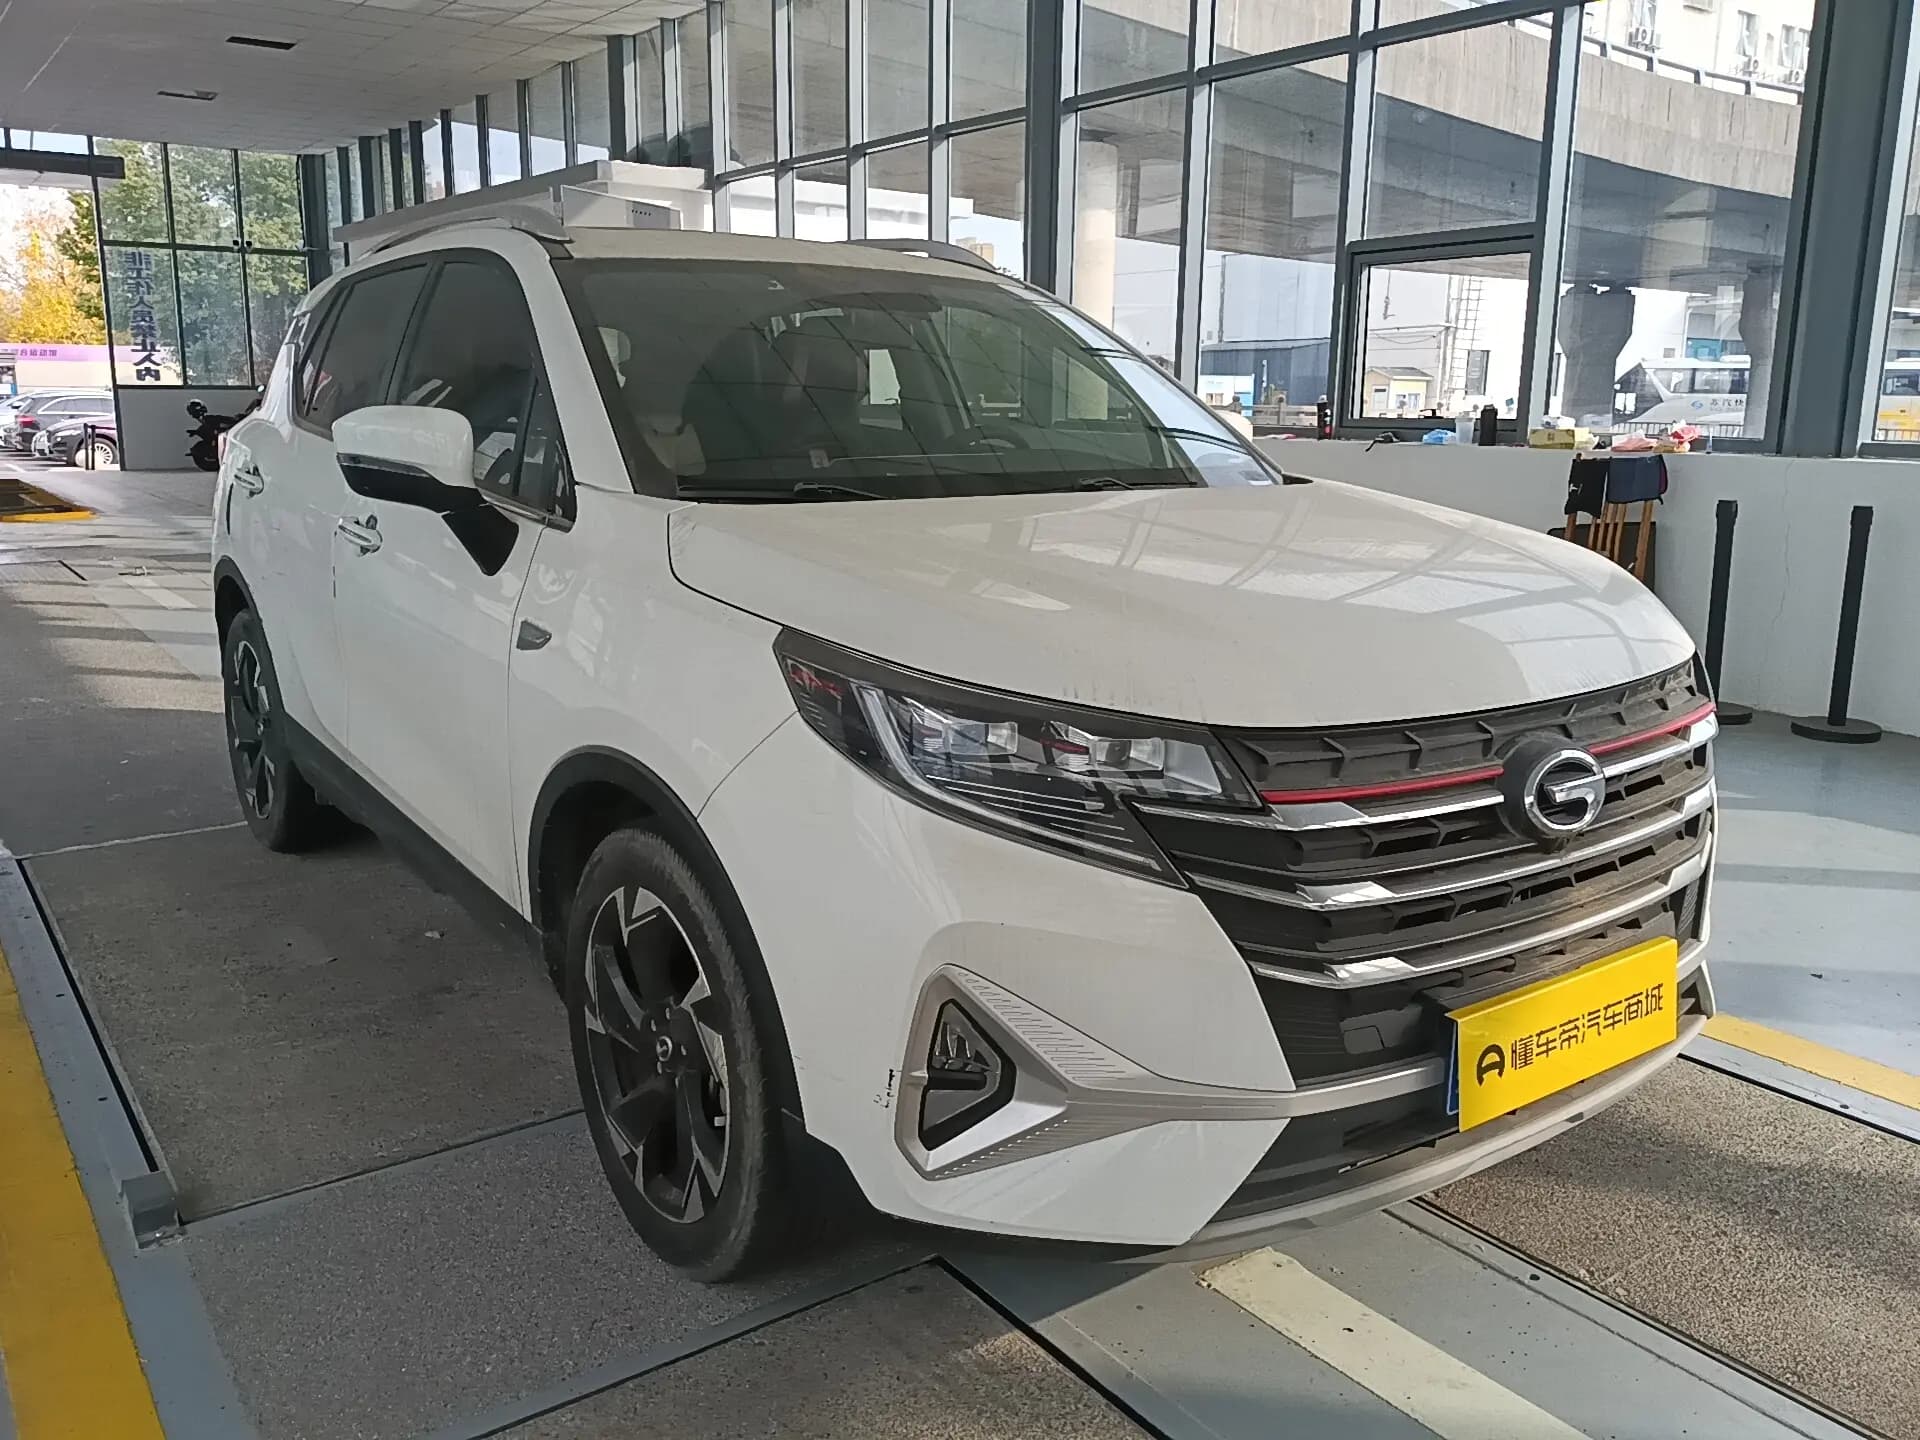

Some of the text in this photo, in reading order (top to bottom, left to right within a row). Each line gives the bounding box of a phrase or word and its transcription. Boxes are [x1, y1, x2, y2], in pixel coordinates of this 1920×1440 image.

[1510, 983, 1664, 1071] 懂车帝汽车商城
